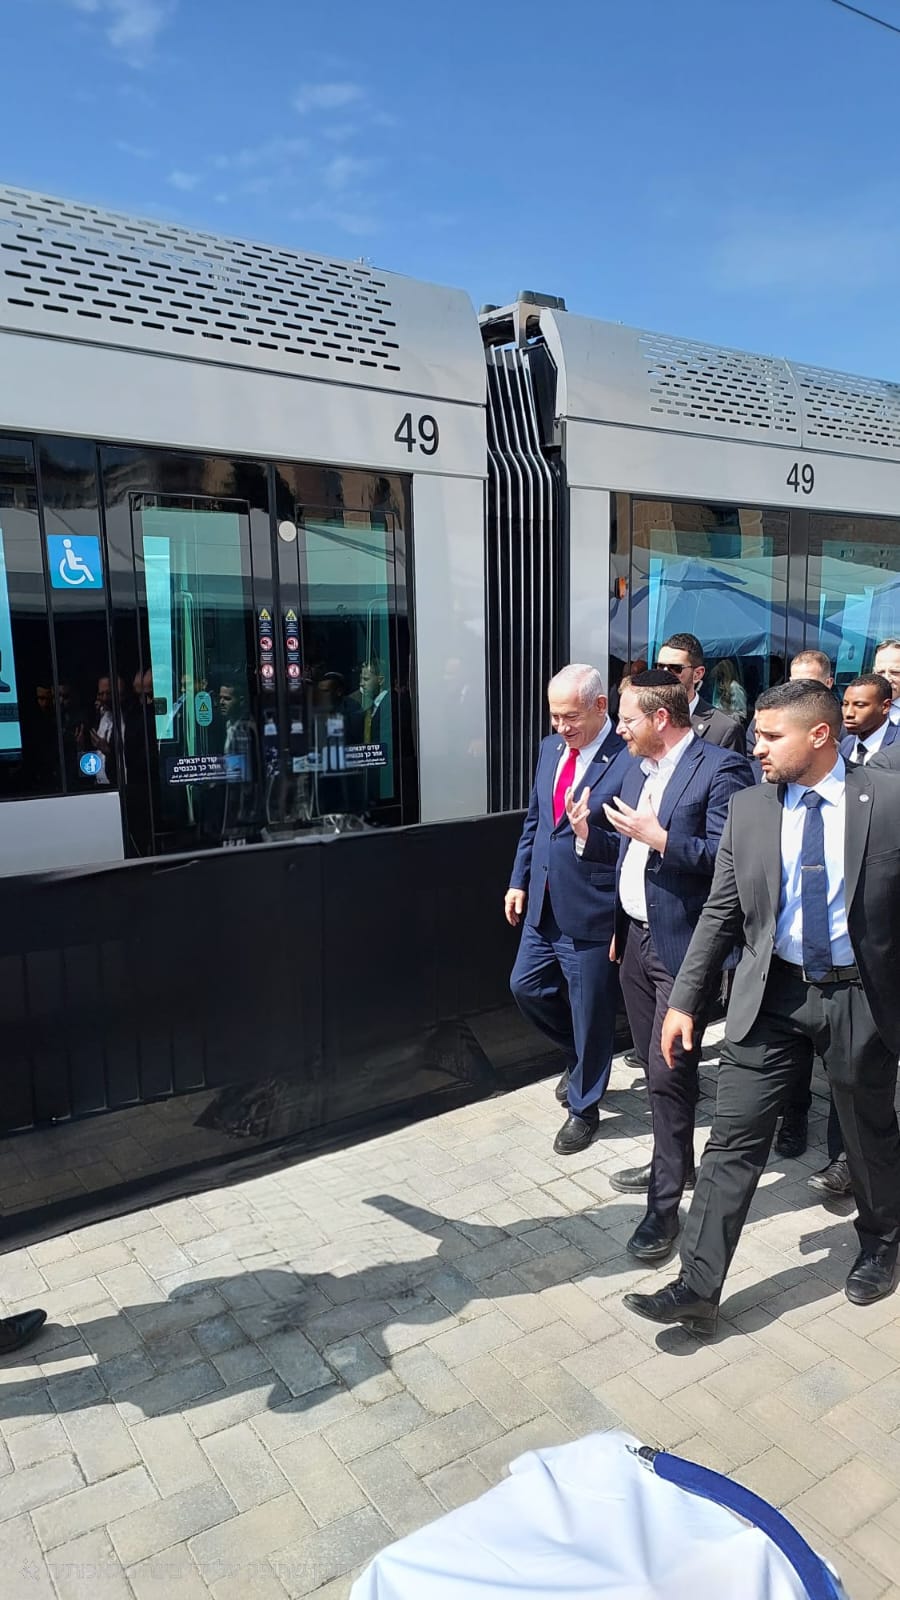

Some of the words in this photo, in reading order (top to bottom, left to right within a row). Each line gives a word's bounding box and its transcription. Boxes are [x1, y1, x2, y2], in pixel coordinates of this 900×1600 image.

[394, 413, 439, 455] 49
[786, 462, 815, 494] 49
[173, 765, 197, 773] נכנסים
